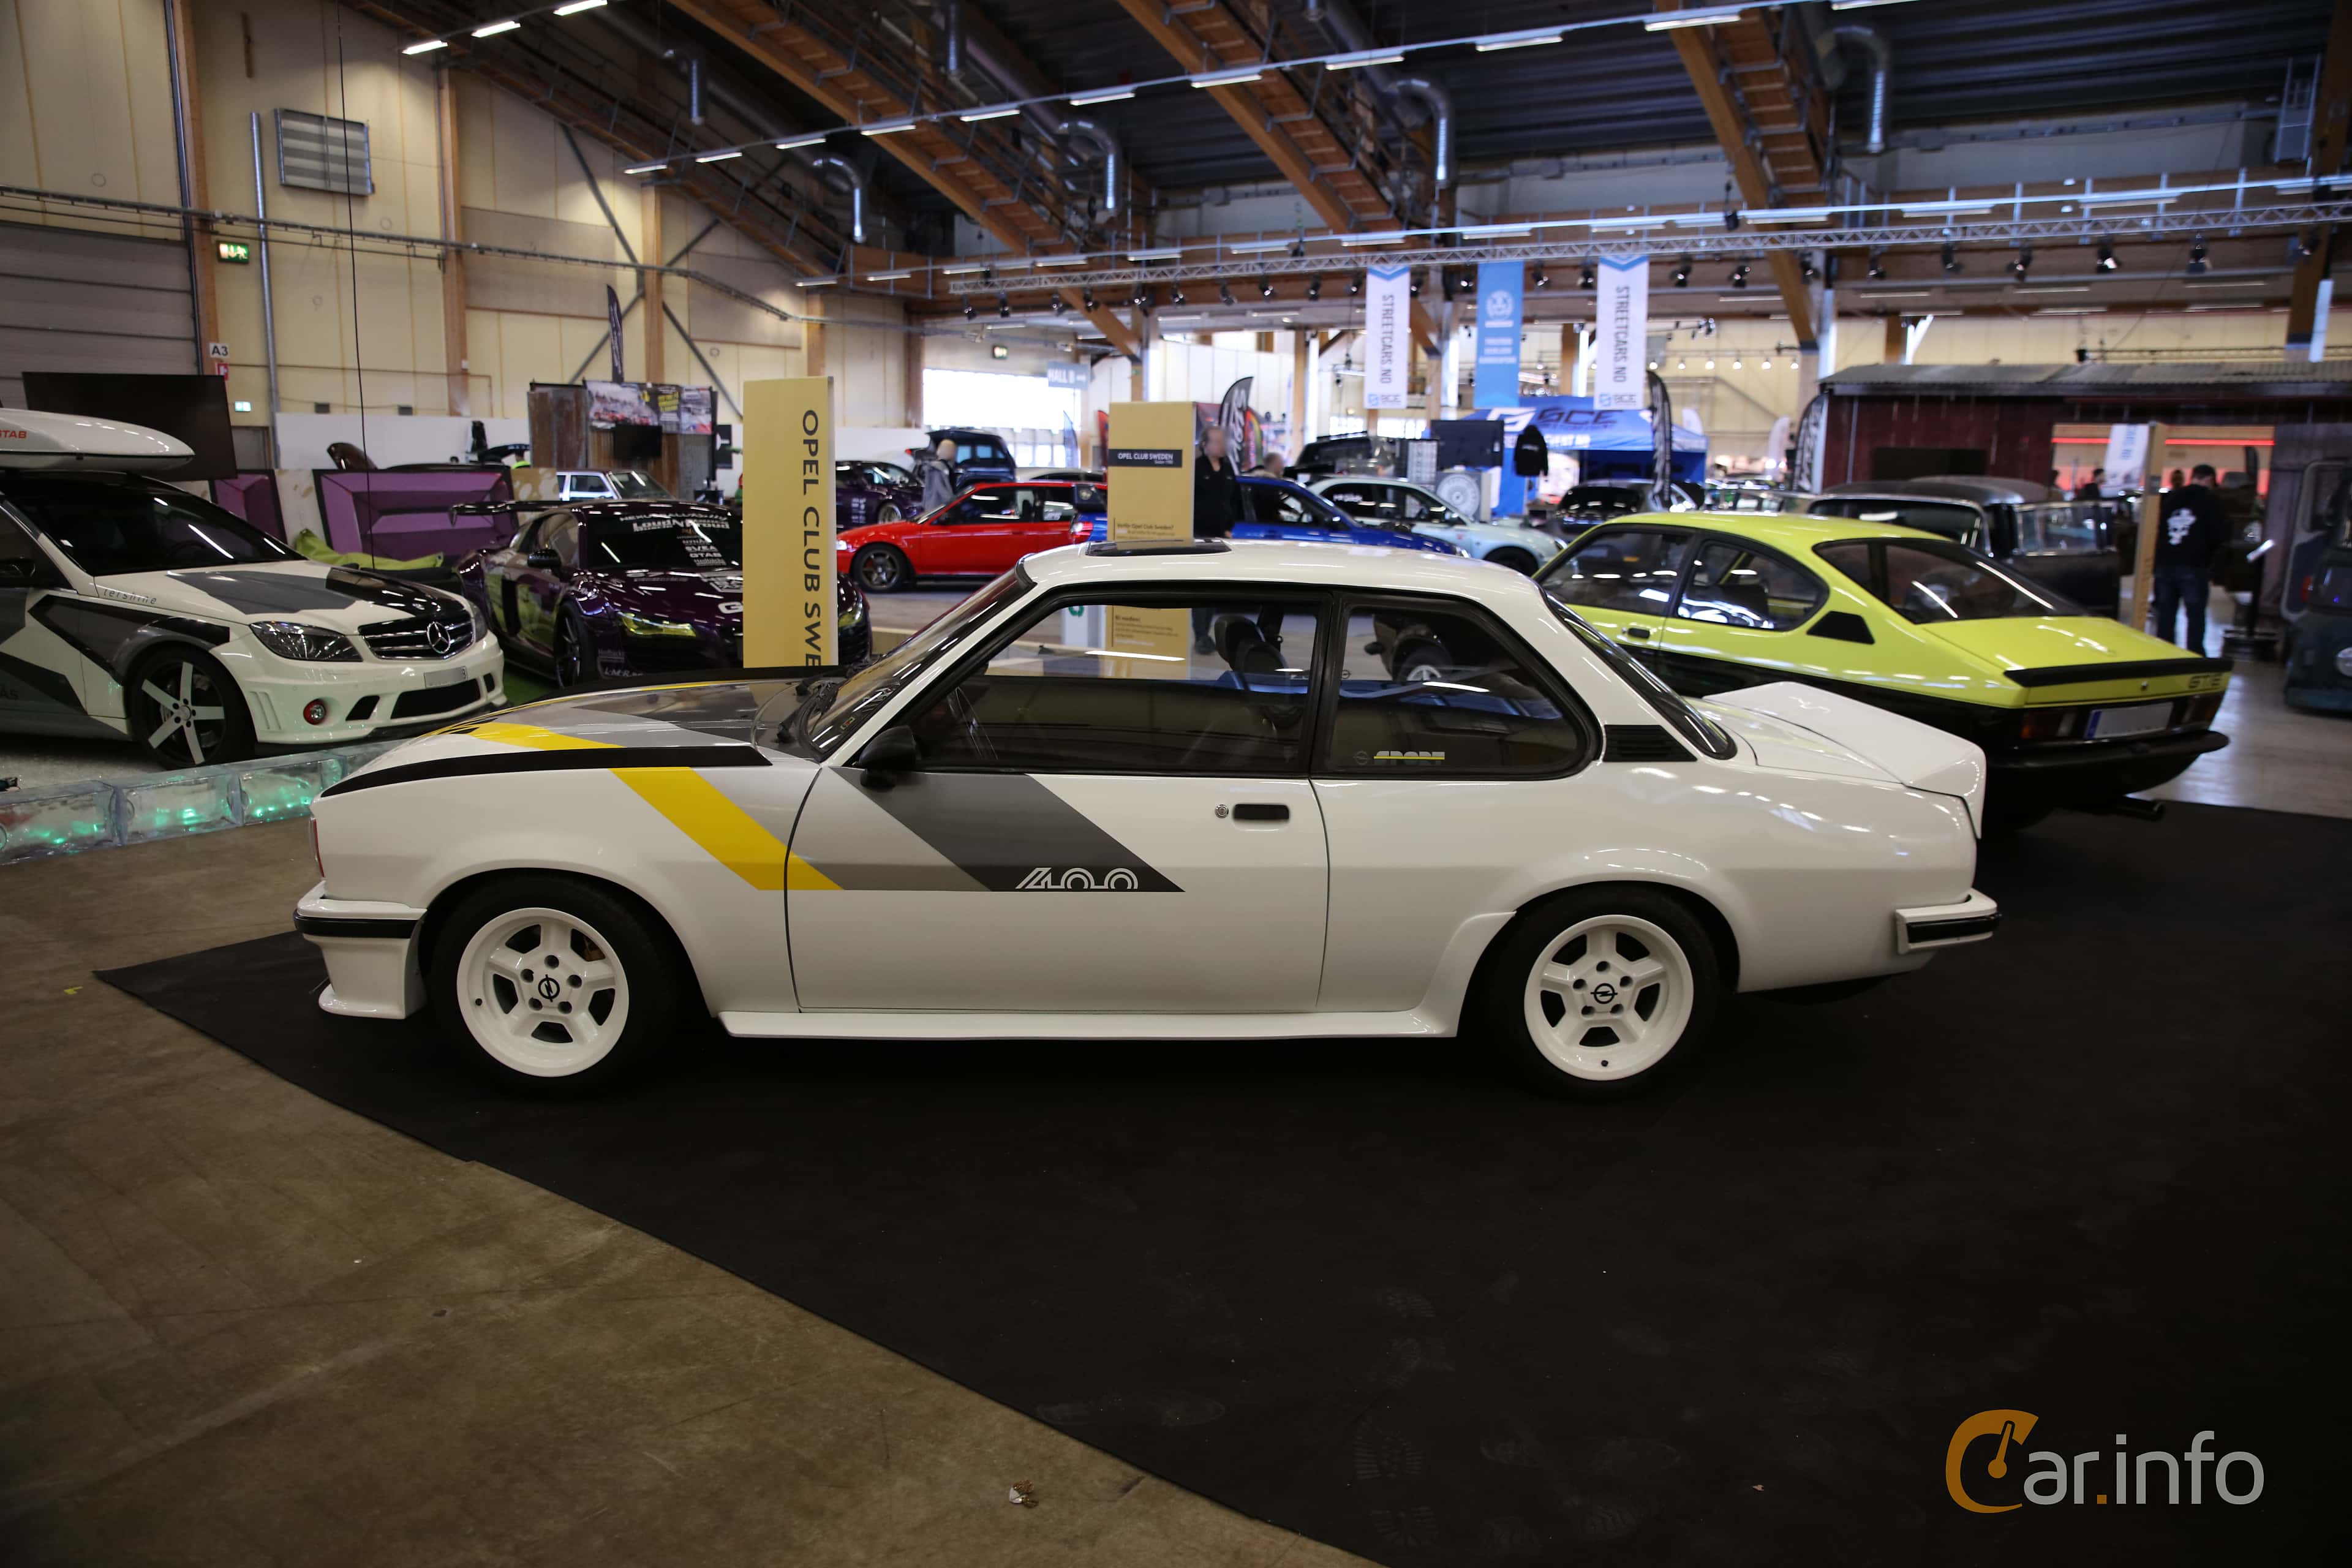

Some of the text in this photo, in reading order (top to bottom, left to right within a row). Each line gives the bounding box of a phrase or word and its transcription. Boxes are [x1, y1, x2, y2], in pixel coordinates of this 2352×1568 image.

[212, 345, 228, 356] A3
[0, 429, 27, 439] TAB
[802, 409, 820, 496] OPEL
[803, 506, 821, 592] CLUB
[1014, 867, 1139, 889] 400
